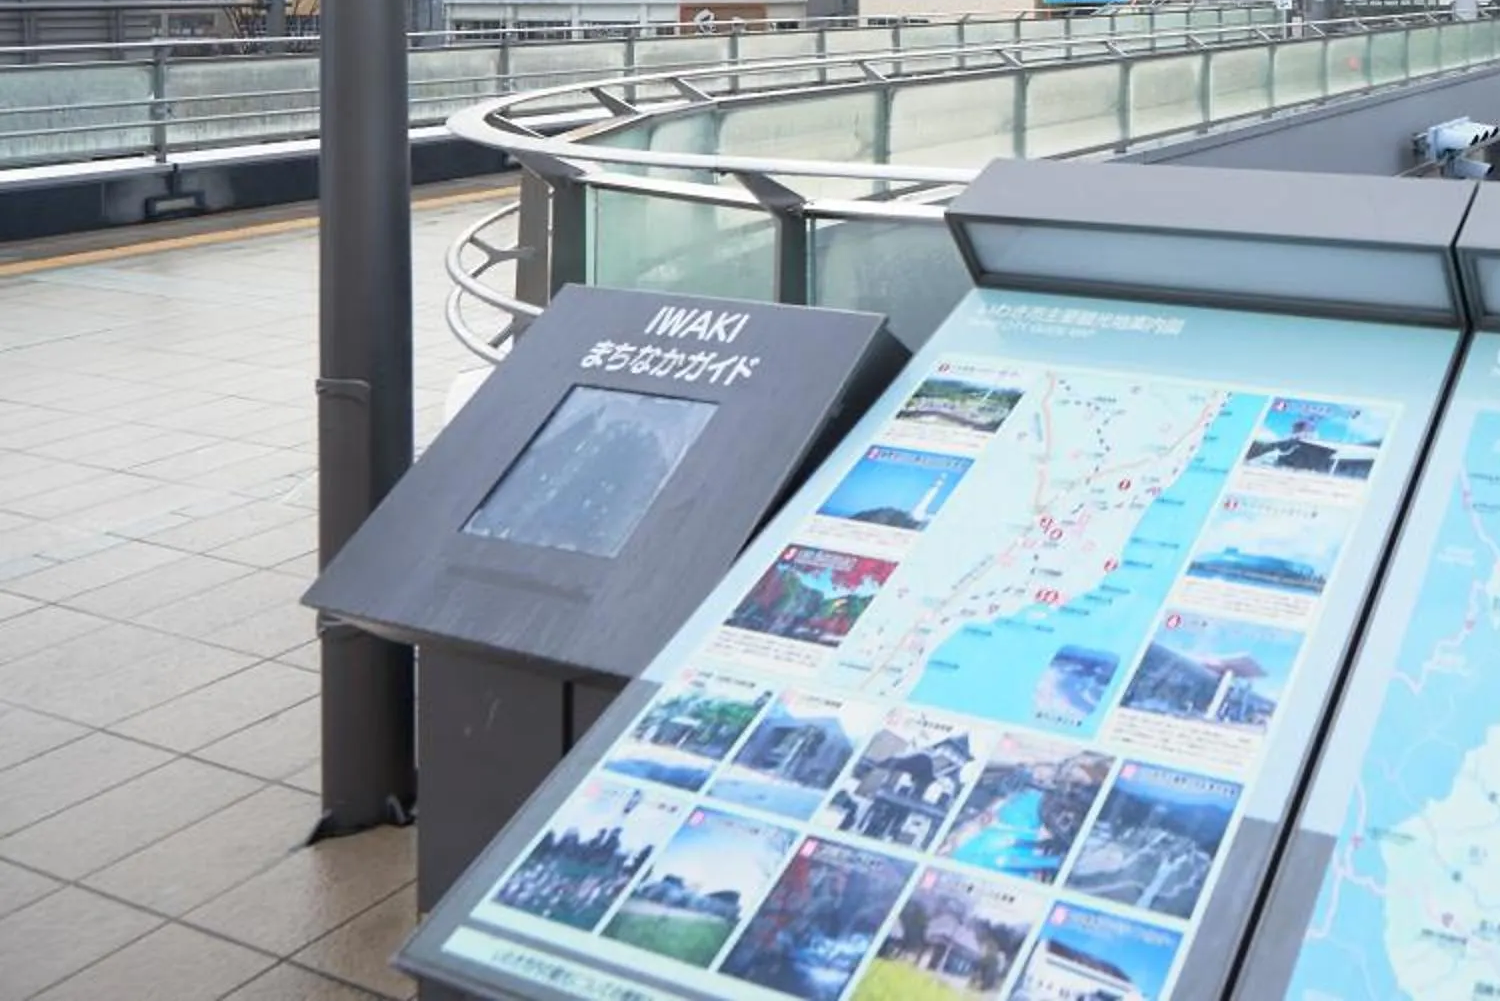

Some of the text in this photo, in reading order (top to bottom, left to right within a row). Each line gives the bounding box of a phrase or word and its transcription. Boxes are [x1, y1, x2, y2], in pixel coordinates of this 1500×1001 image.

[644, 306, 750, 343] IWAKI
[580, 339, 760, 386] まちなかガイド
